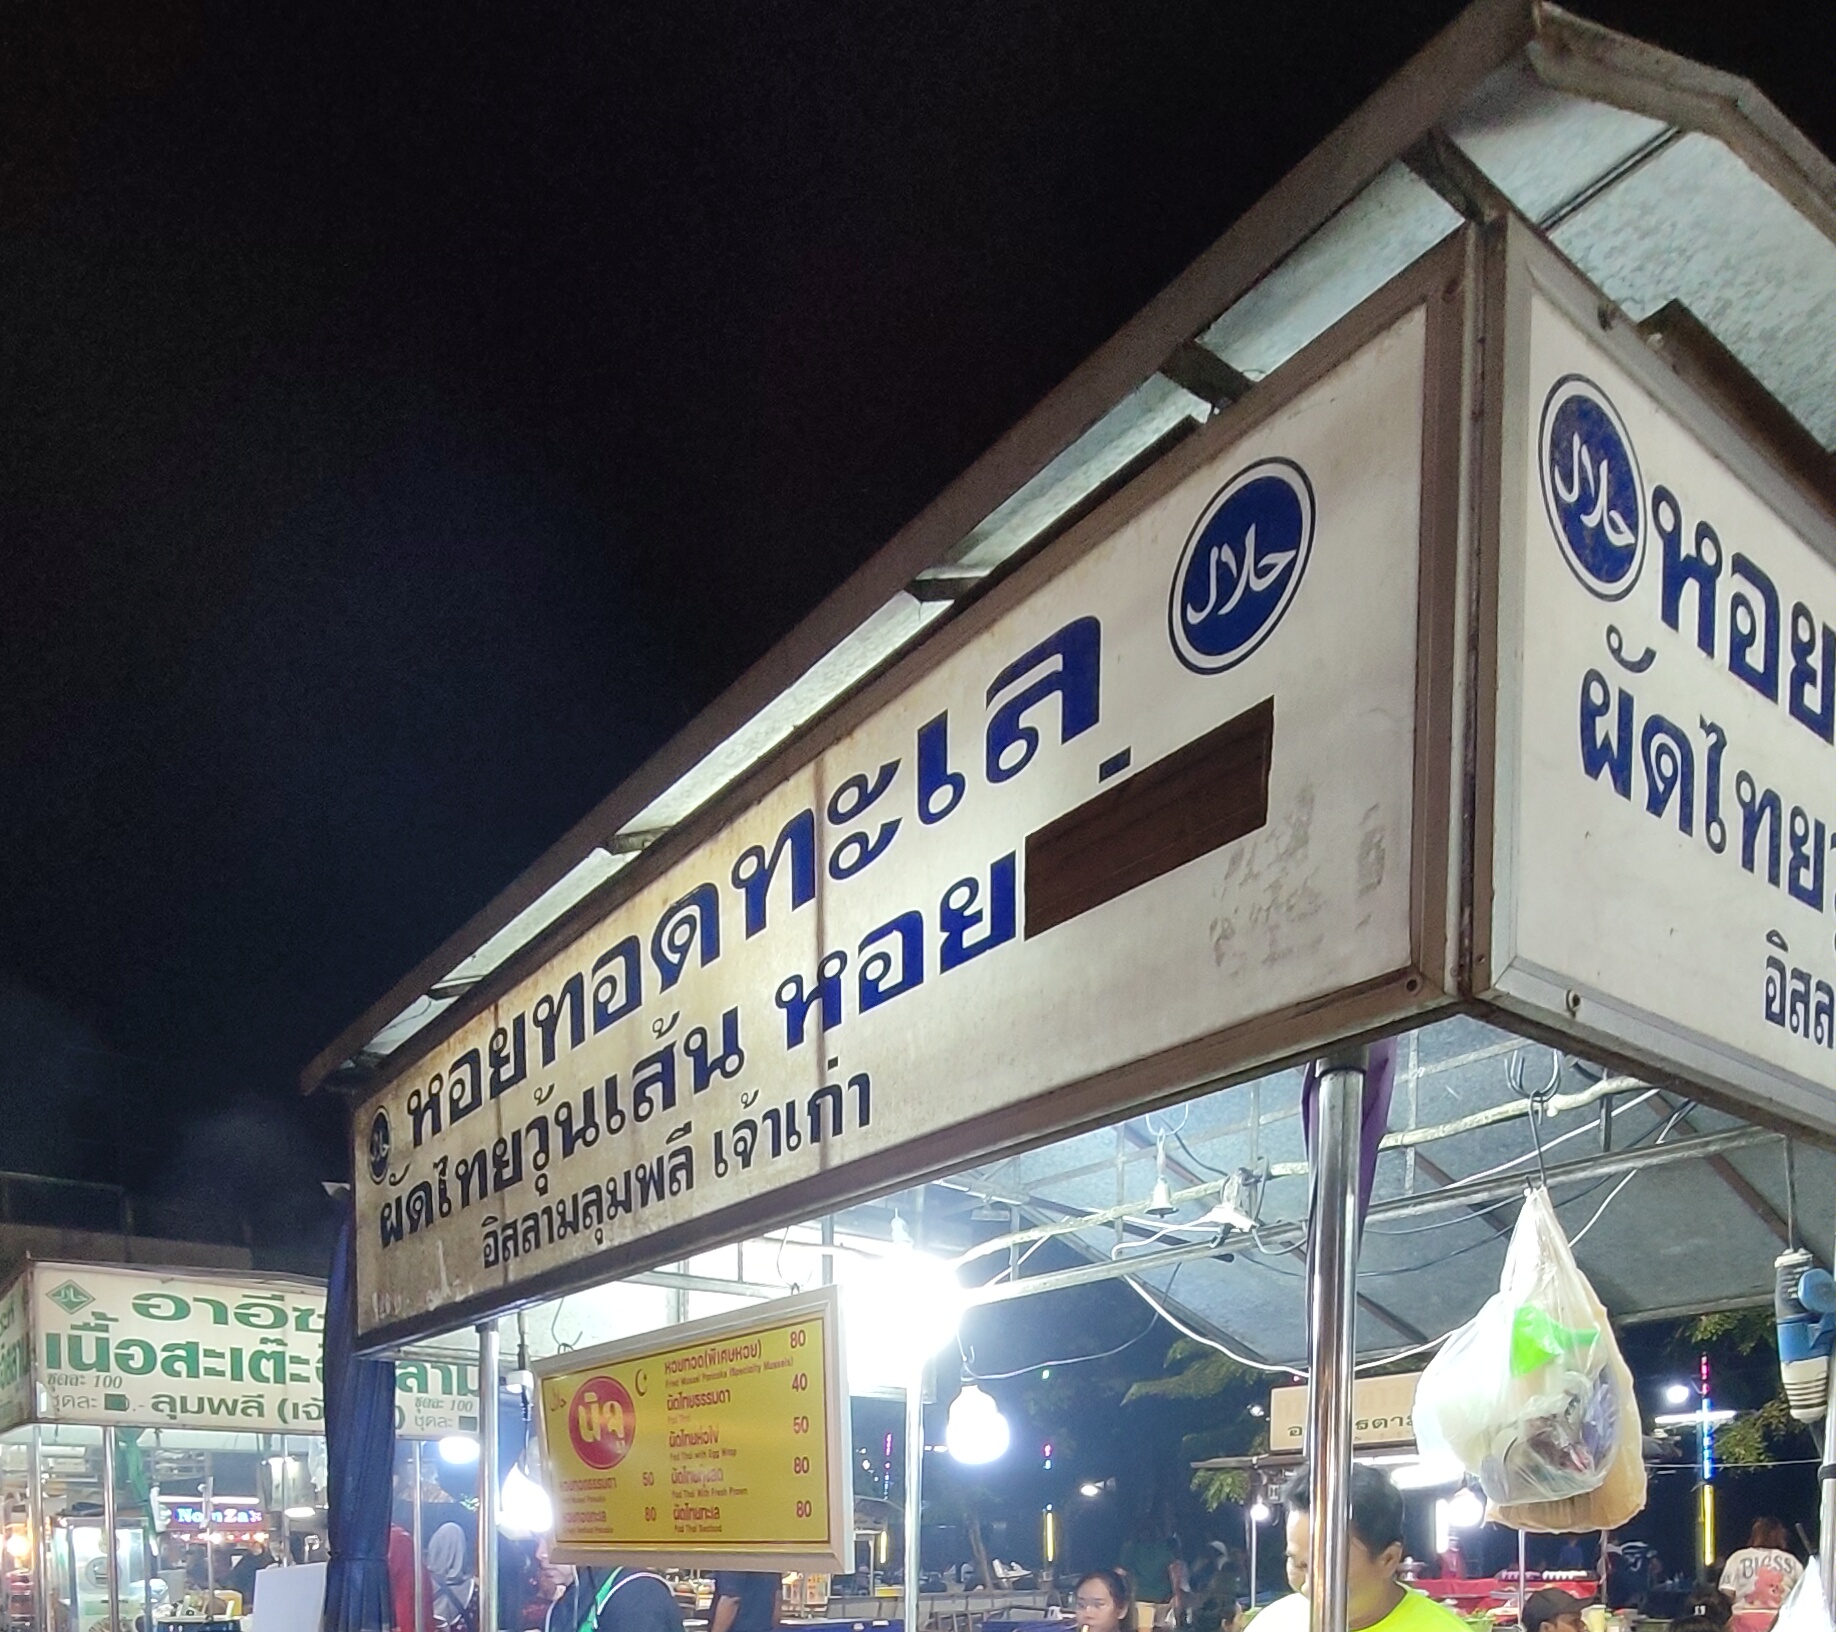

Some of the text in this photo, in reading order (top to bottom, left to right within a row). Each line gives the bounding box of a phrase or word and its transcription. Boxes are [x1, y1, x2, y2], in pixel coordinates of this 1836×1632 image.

[1187, 523, 1297, 625] حلال
[1580, 624, 1836, 914] ผัดไทย
[406, 615, 1101, 1149] หอยทอดทะเล
[380, 850, 1017, 1249] ผัดไทยวุ้นเส้น หอย
[483, 1056, 872, 1269] อิสลามลุมพลี เจ้าเก่า
[789, 1329, 807, 1349] 80
[93, 1375, 122, 1389] 100
[791, 1372, 808, 1392] 40
[450, 1400, 473, 1412] 100
[793, 1415, 810, 1434] 50
[793, 1456, 810, 1474] 80
[642, 1471, 654, 1487] 50
[644, 1506, 657, 1522] 80
[796, 1499, 812, 1518] 80
